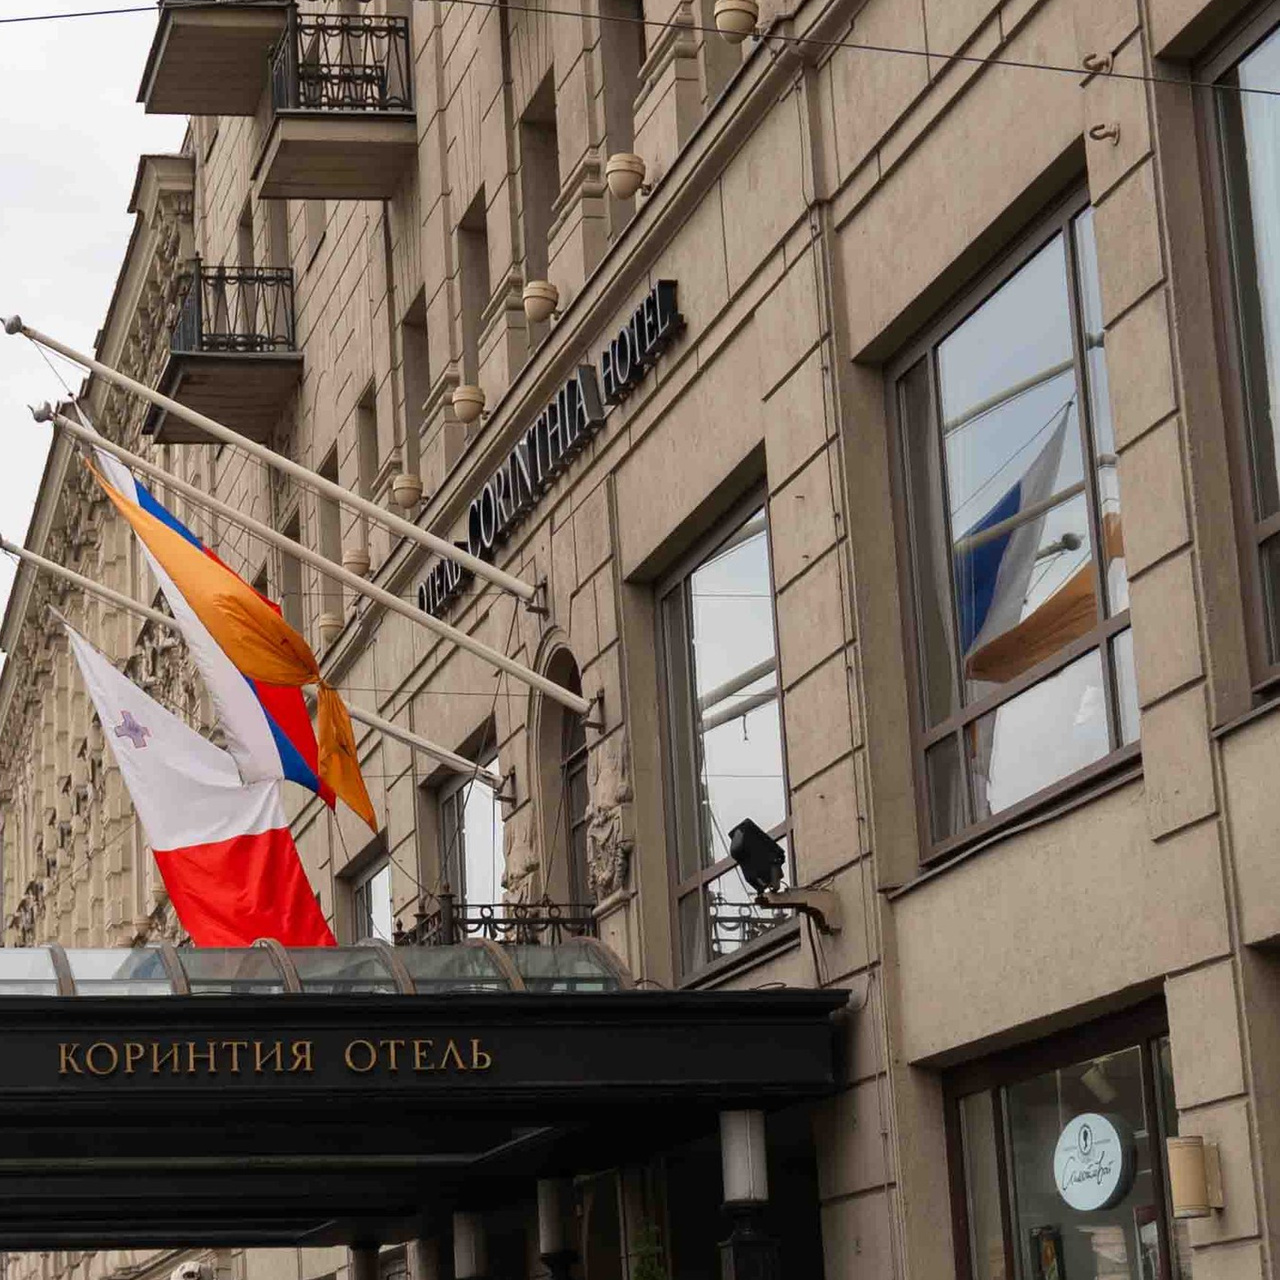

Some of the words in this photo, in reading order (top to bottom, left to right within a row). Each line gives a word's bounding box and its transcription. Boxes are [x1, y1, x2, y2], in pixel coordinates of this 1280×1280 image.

[467, 365, 604, 559] CORINTHIA
[601, 279, 678, 404] HOTEL
[58, 1040, 314, 1075] КОРИНТИЯ
[344, 1038, 493, 1072] ОТЕЛЬ
